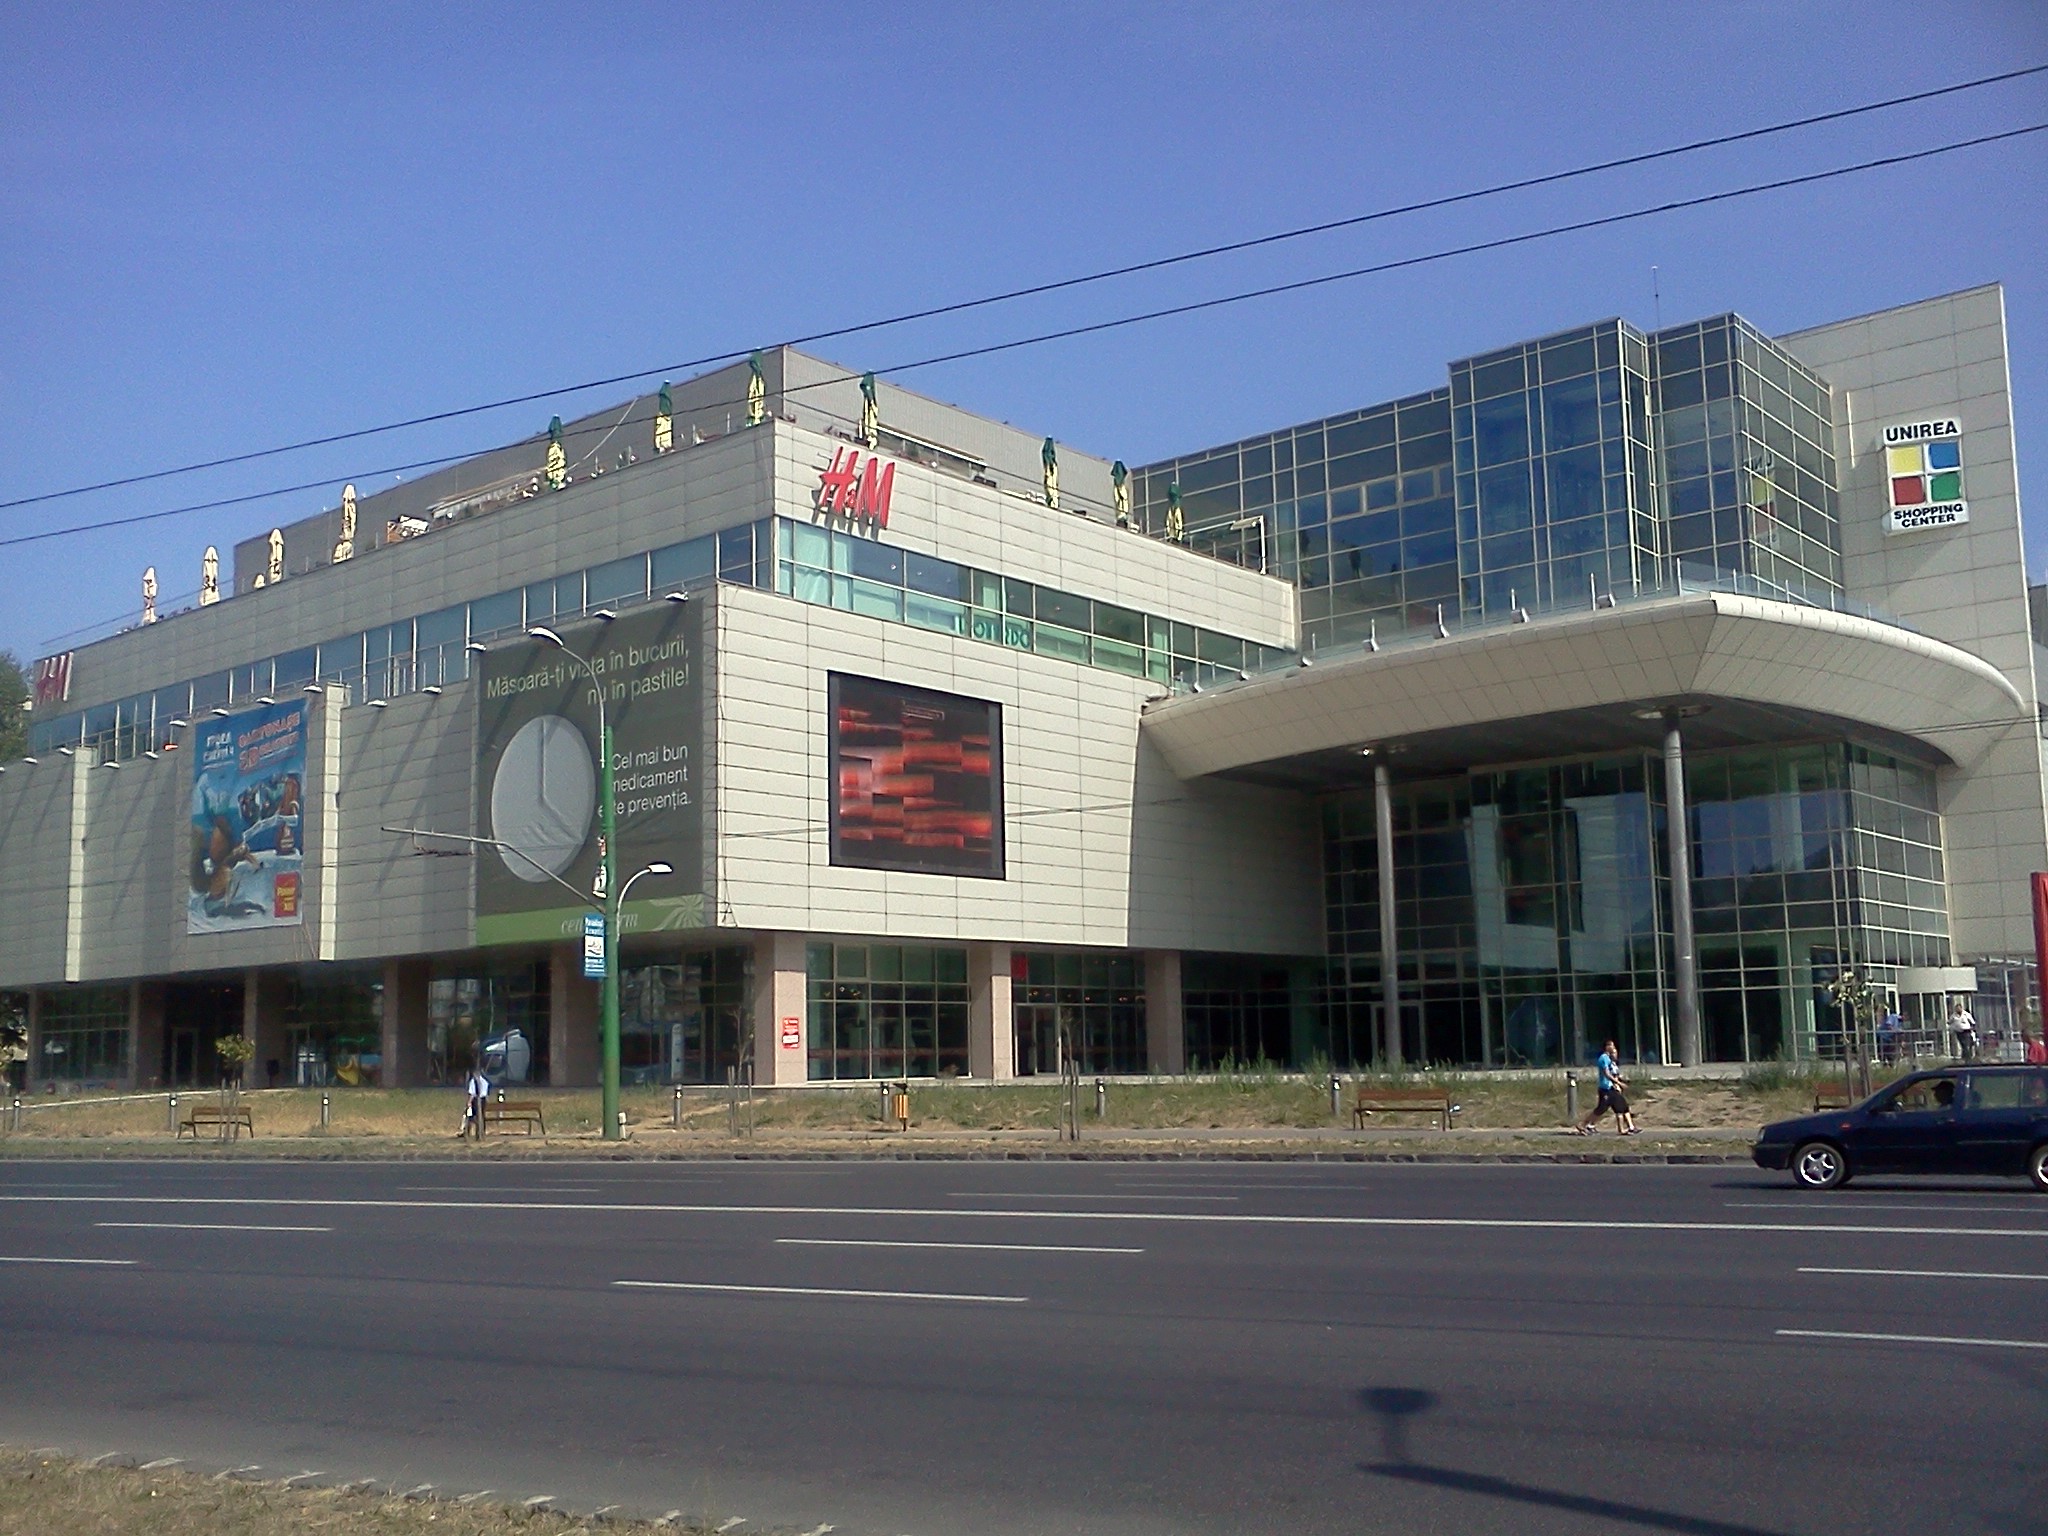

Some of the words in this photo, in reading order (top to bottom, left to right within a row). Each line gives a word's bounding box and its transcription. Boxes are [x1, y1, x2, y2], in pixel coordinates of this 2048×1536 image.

[1886, 421, 1958, 442] UNIREA
[818, 446, 896, 530] H&M
[1894, 503, 1963, 520] SHOPPING
[1901, 514, 1956, 528] CENTER
[629, 634, 689, 666] bucurii,
[631, 663, 689, 701] pastile!
[611, 751, 633, 771] Cel
[635, 746, 659, 767] mai
[663, 745, 688, 762] bun
